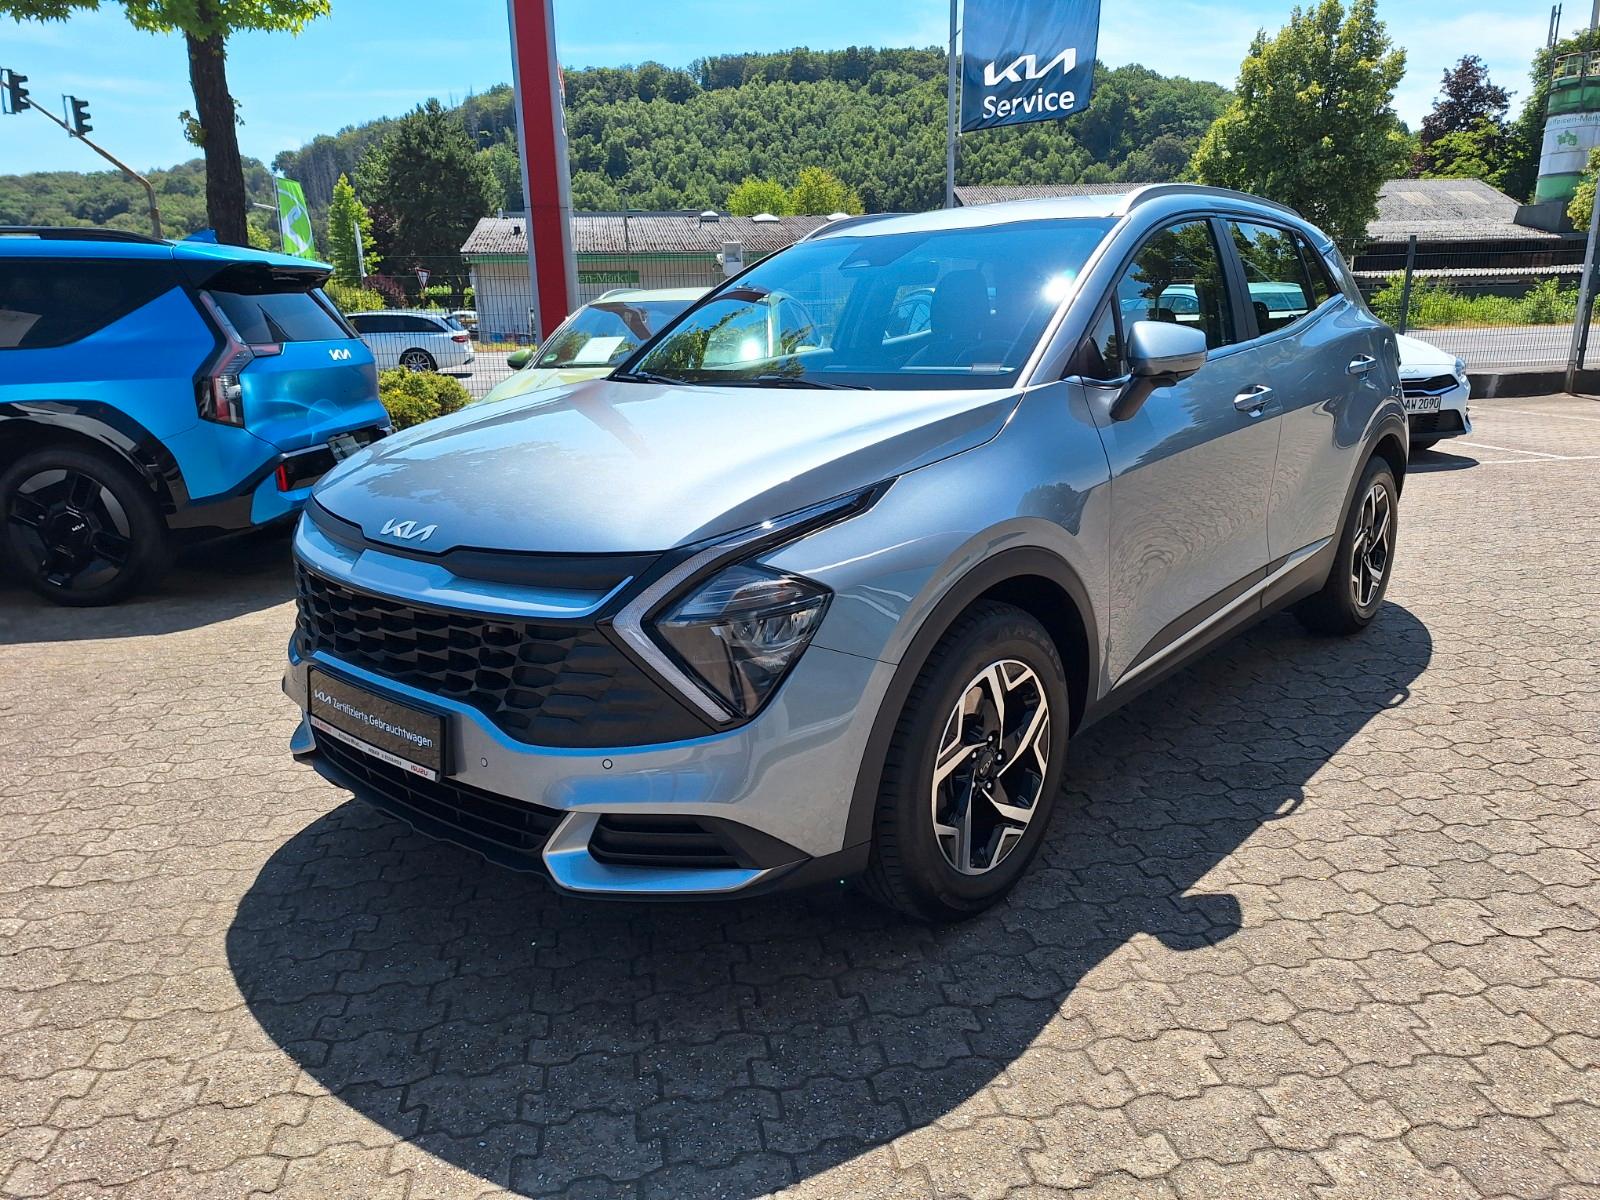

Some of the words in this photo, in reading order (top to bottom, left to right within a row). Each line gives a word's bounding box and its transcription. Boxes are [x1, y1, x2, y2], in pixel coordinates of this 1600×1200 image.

[983, 47, 1077, 86] KIA
[982, 87, 1075, 119] Service
[328, 348, 352, 361] KIA
[1418, 398, 1439, 410] 2090
[380, 517, 438, 542] KIA
[314, 689, 332, 704] KIA
[333, 698, 368, 721] Zertifizierte
[369, 714, 433, 748] Gebrauchtwagen
